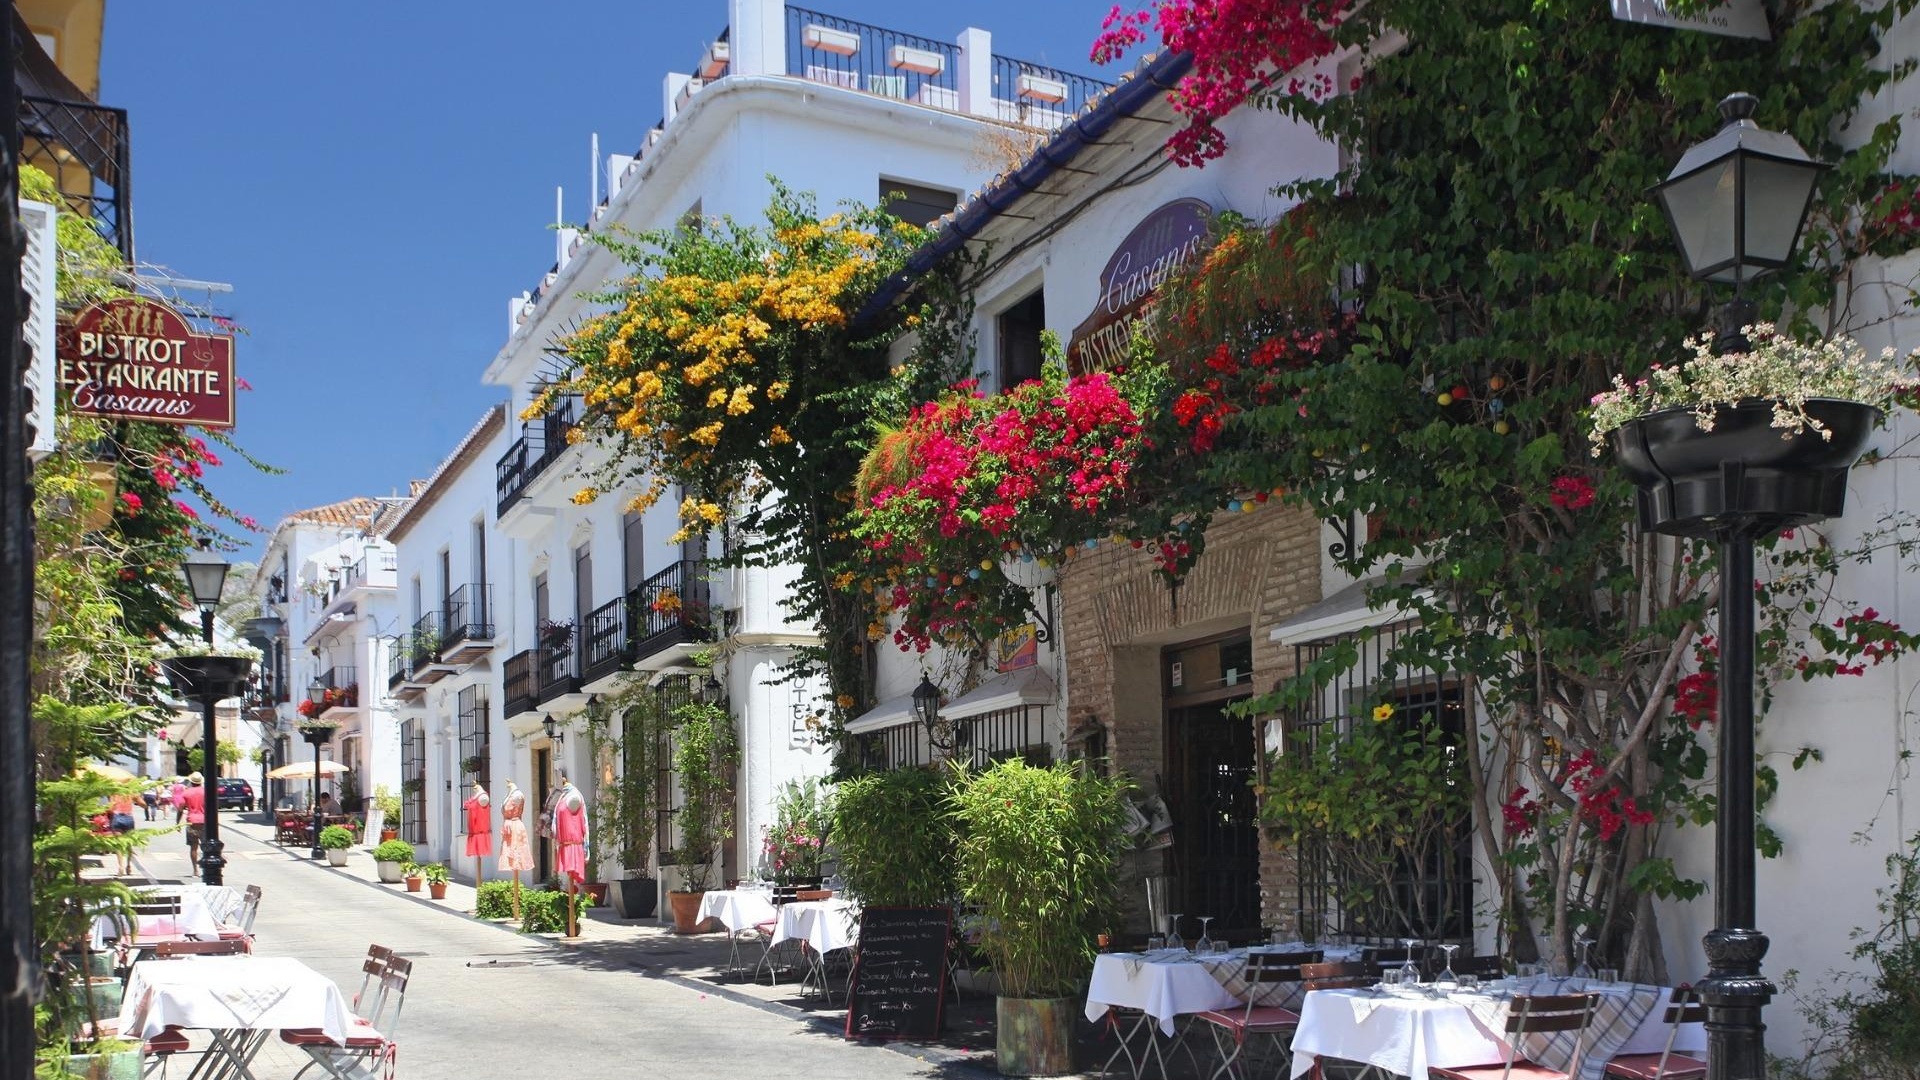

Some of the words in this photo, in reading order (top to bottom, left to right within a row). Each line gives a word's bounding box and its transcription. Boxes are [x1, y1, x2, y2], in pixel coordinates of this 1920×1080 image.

[1107, 224, 1200, 315] Casanis
[80, 331, 187, 365] BISTROT
[56, 358, 221, 396] ESTAURANTE
[71, 378, 196, 416] Casanis
[792, 674, 807, 733] OTEL
